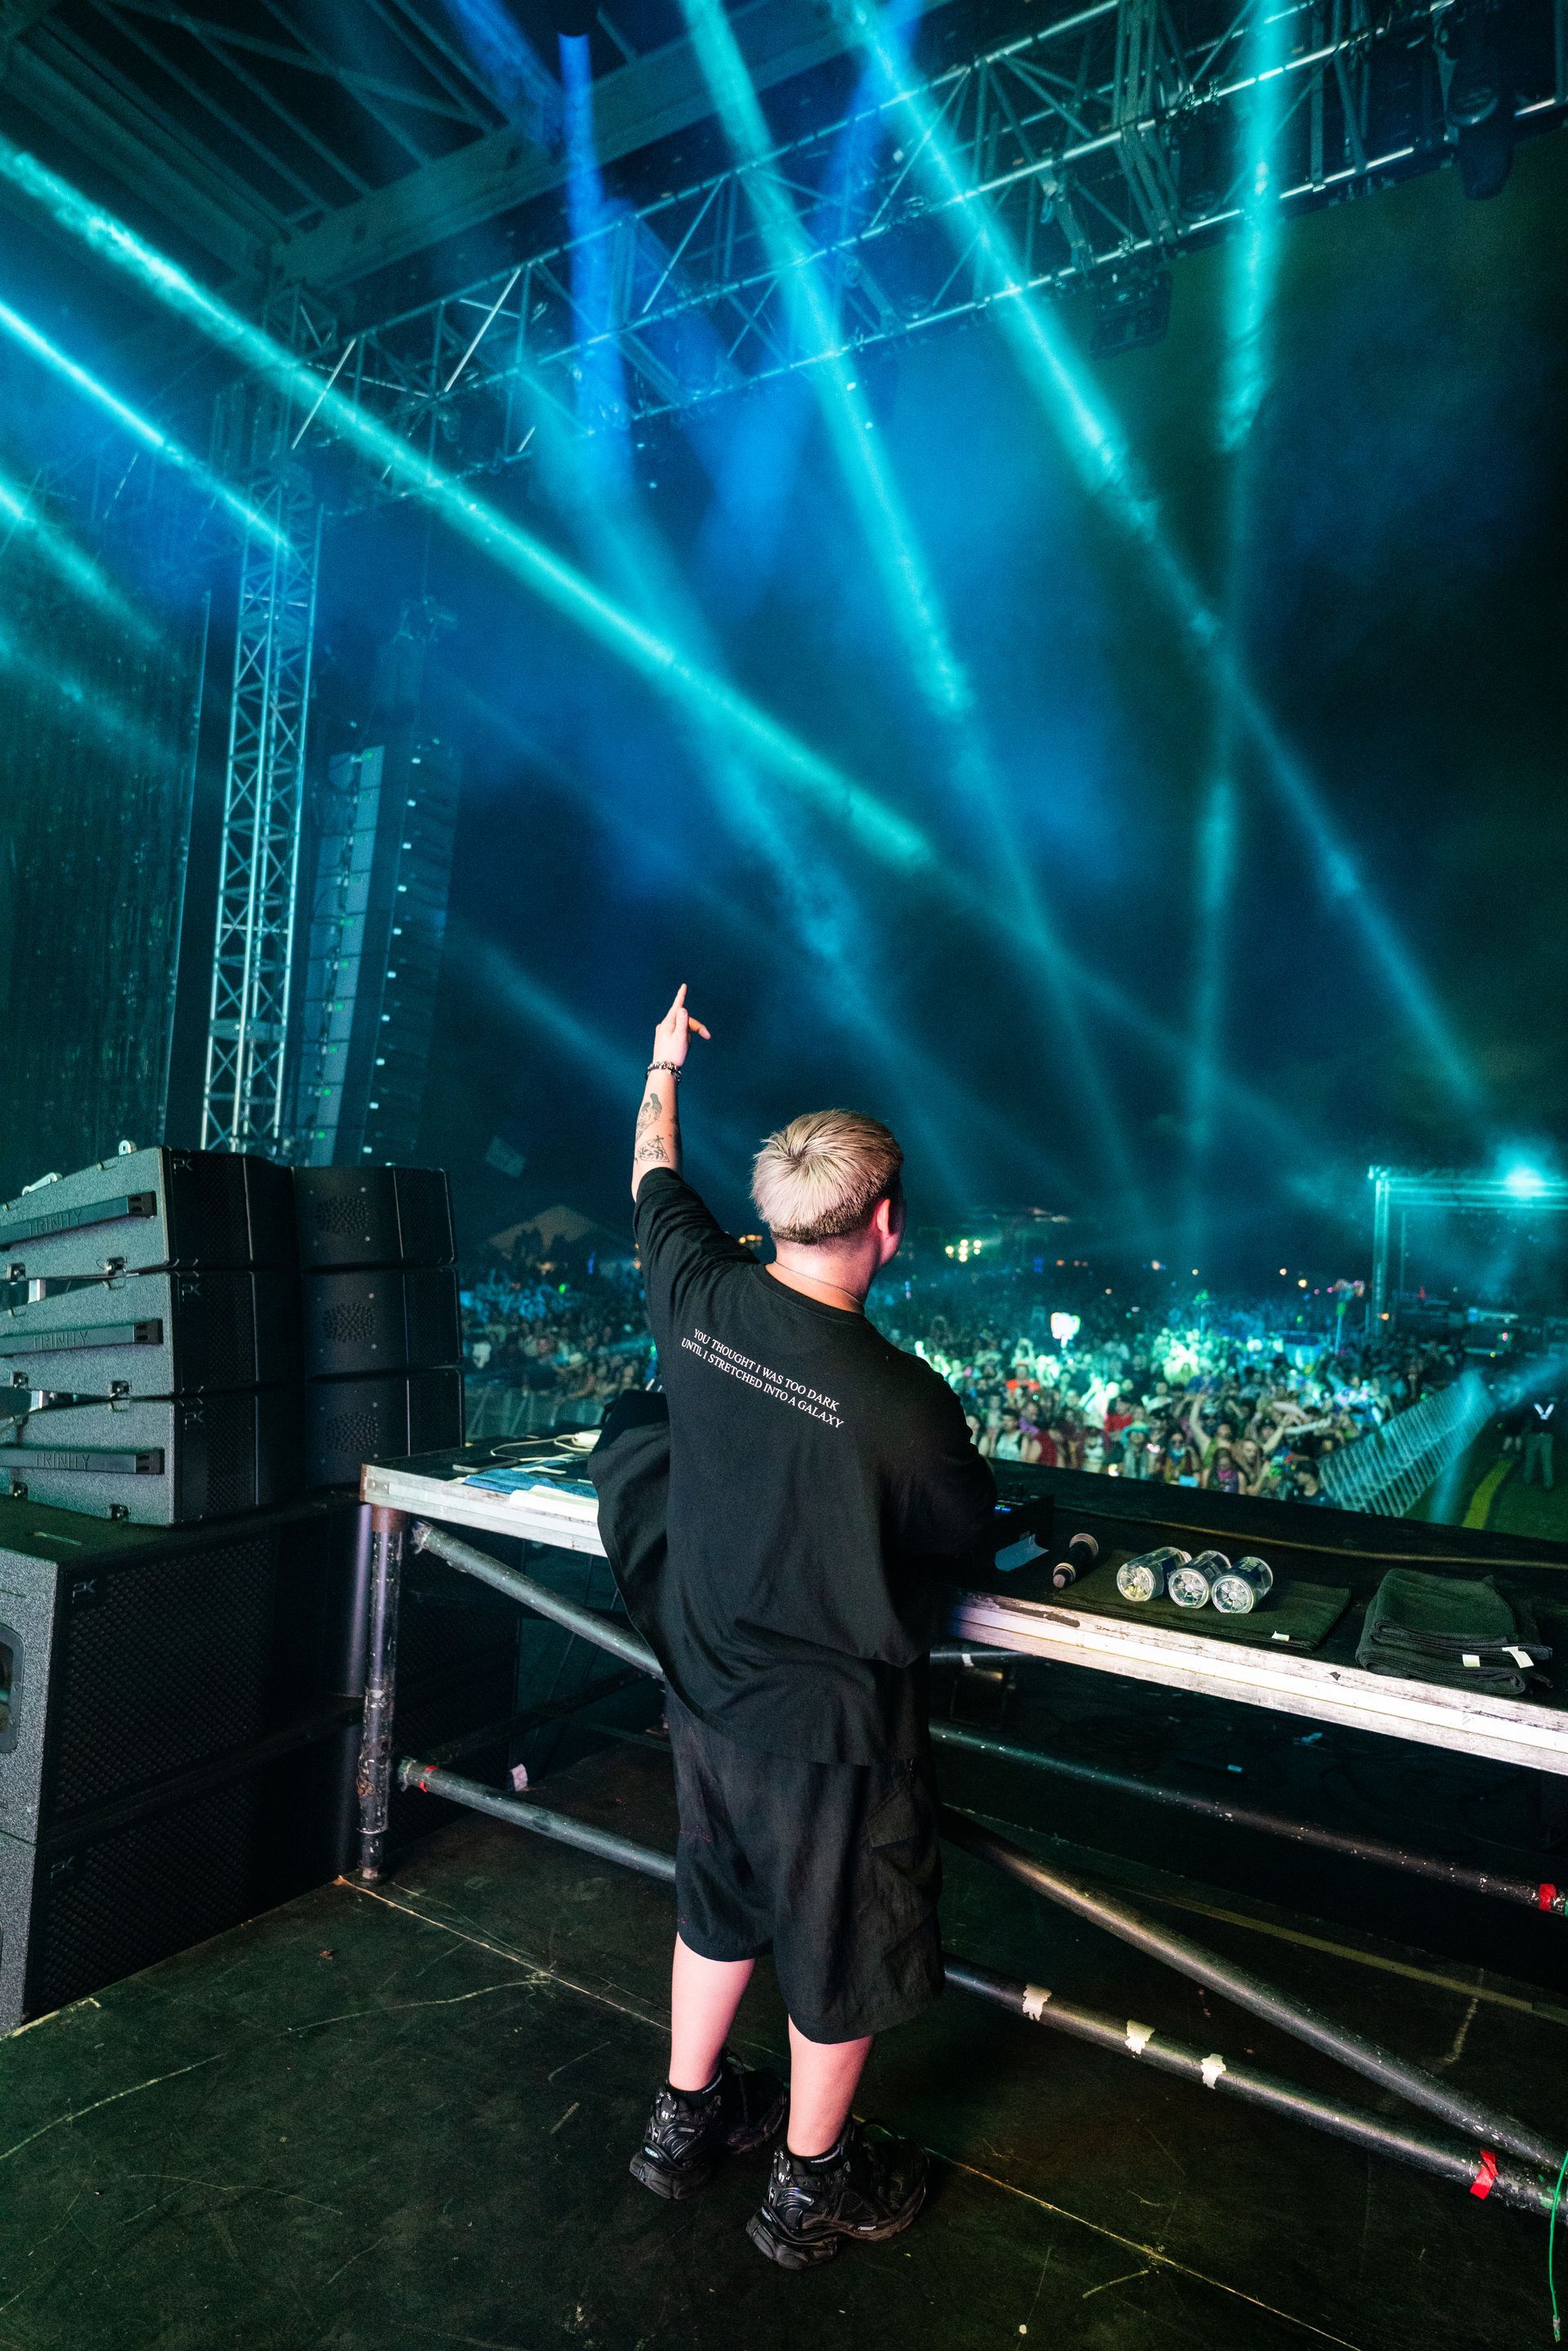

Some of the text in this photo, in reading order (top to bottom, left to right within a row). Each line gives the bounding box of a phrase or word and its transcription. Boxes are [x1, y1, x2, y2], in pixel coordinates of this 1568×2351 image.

[681, 1338, 844, 1428] UNTIL I STRETCHED INTO A GALAXY
[694, 1329, 840, 1412] YOU THOUGHT I WAS TOO DARK
